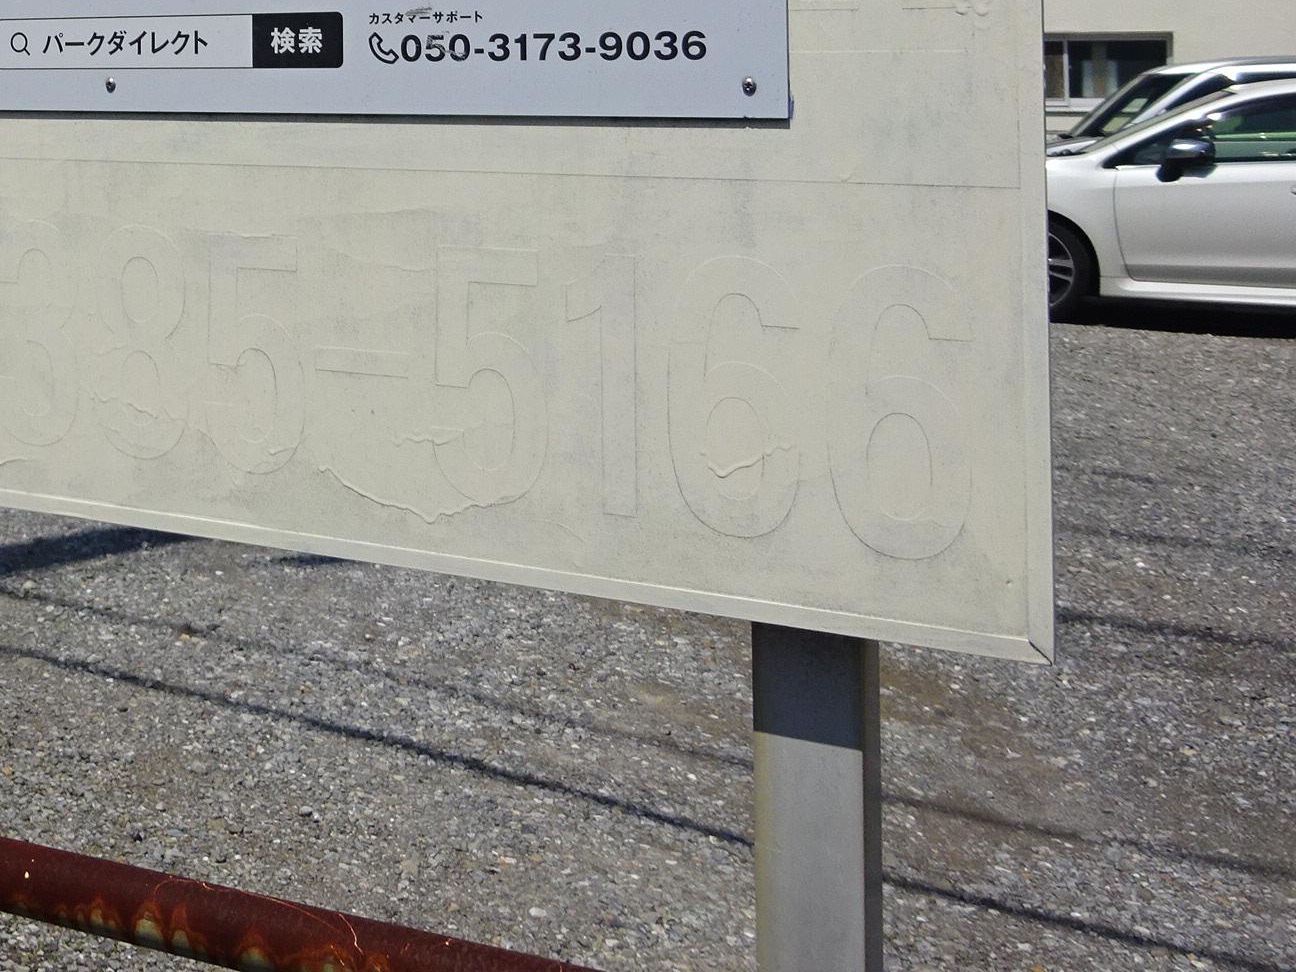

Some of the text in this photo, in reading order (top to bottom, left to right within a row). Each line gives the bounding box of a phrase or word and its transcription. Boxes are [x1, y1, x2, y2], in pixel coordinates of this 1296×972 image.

[368, 10, 483, 25] カスタマーサポート
[42, 30, 208, 56] パークダイレクト
[270, 26, 323, 54] 検索
[400, 31, 707, 63] 050-3173-9036
